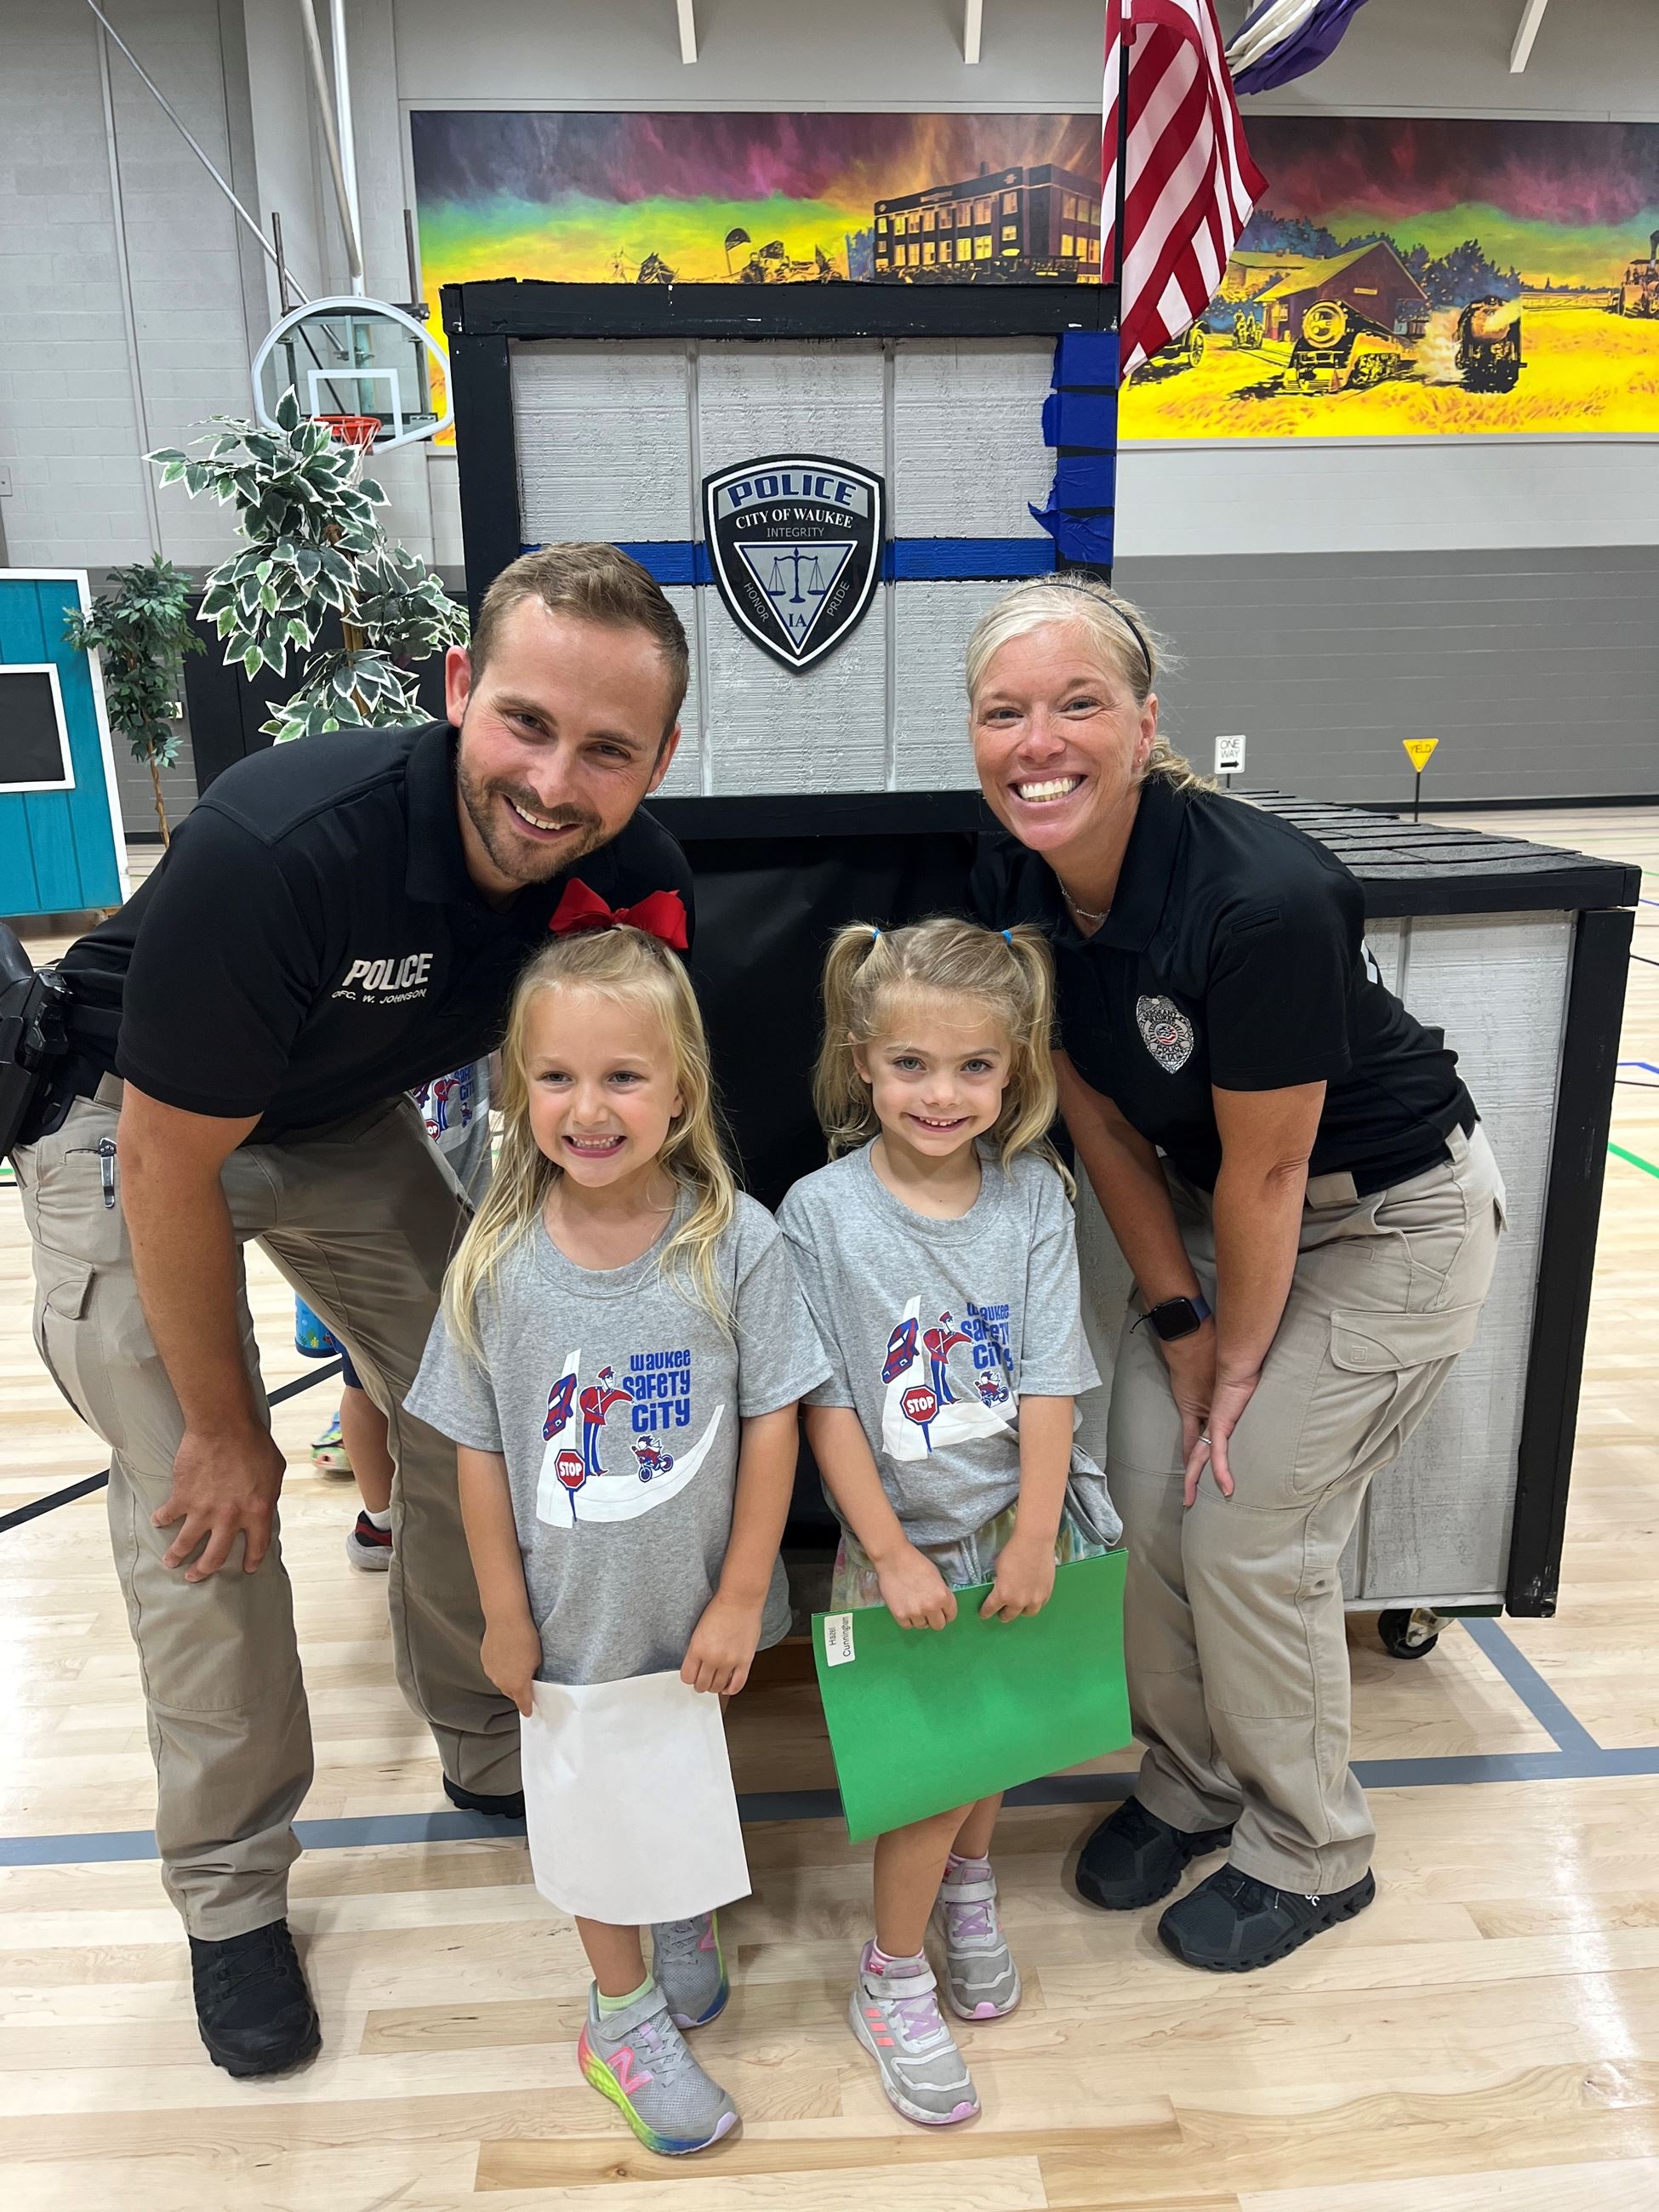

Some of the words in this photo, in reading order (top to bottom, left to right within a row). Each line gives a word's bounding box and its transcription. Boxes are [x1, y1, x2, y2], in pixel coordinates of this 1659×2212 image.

[727, 474, 858, 509] POLICE
[735, 510, 769, 529] CITY
[772, 508, 791, 522] OF
[793, 508, 853, 528] WAUKEE
[767, 527, 825, 538] INTEGRITY
[743, 582, 770, 623] HONOR
[826, 580, 850, 618] PRIDE
[788, 613, 807, 628] IA
[1220, 738, 1240, 750] ONE
[1220, 749, 1240, 758] WAY
[341, 953, 434, 991] POLICE
[362, 995, 375, 1004] W.
[379, 989, 427, 1005] JOHNSON
[906, 1395, 935, 1415] STOP
[559, 1461, 582, 1477] STOP
